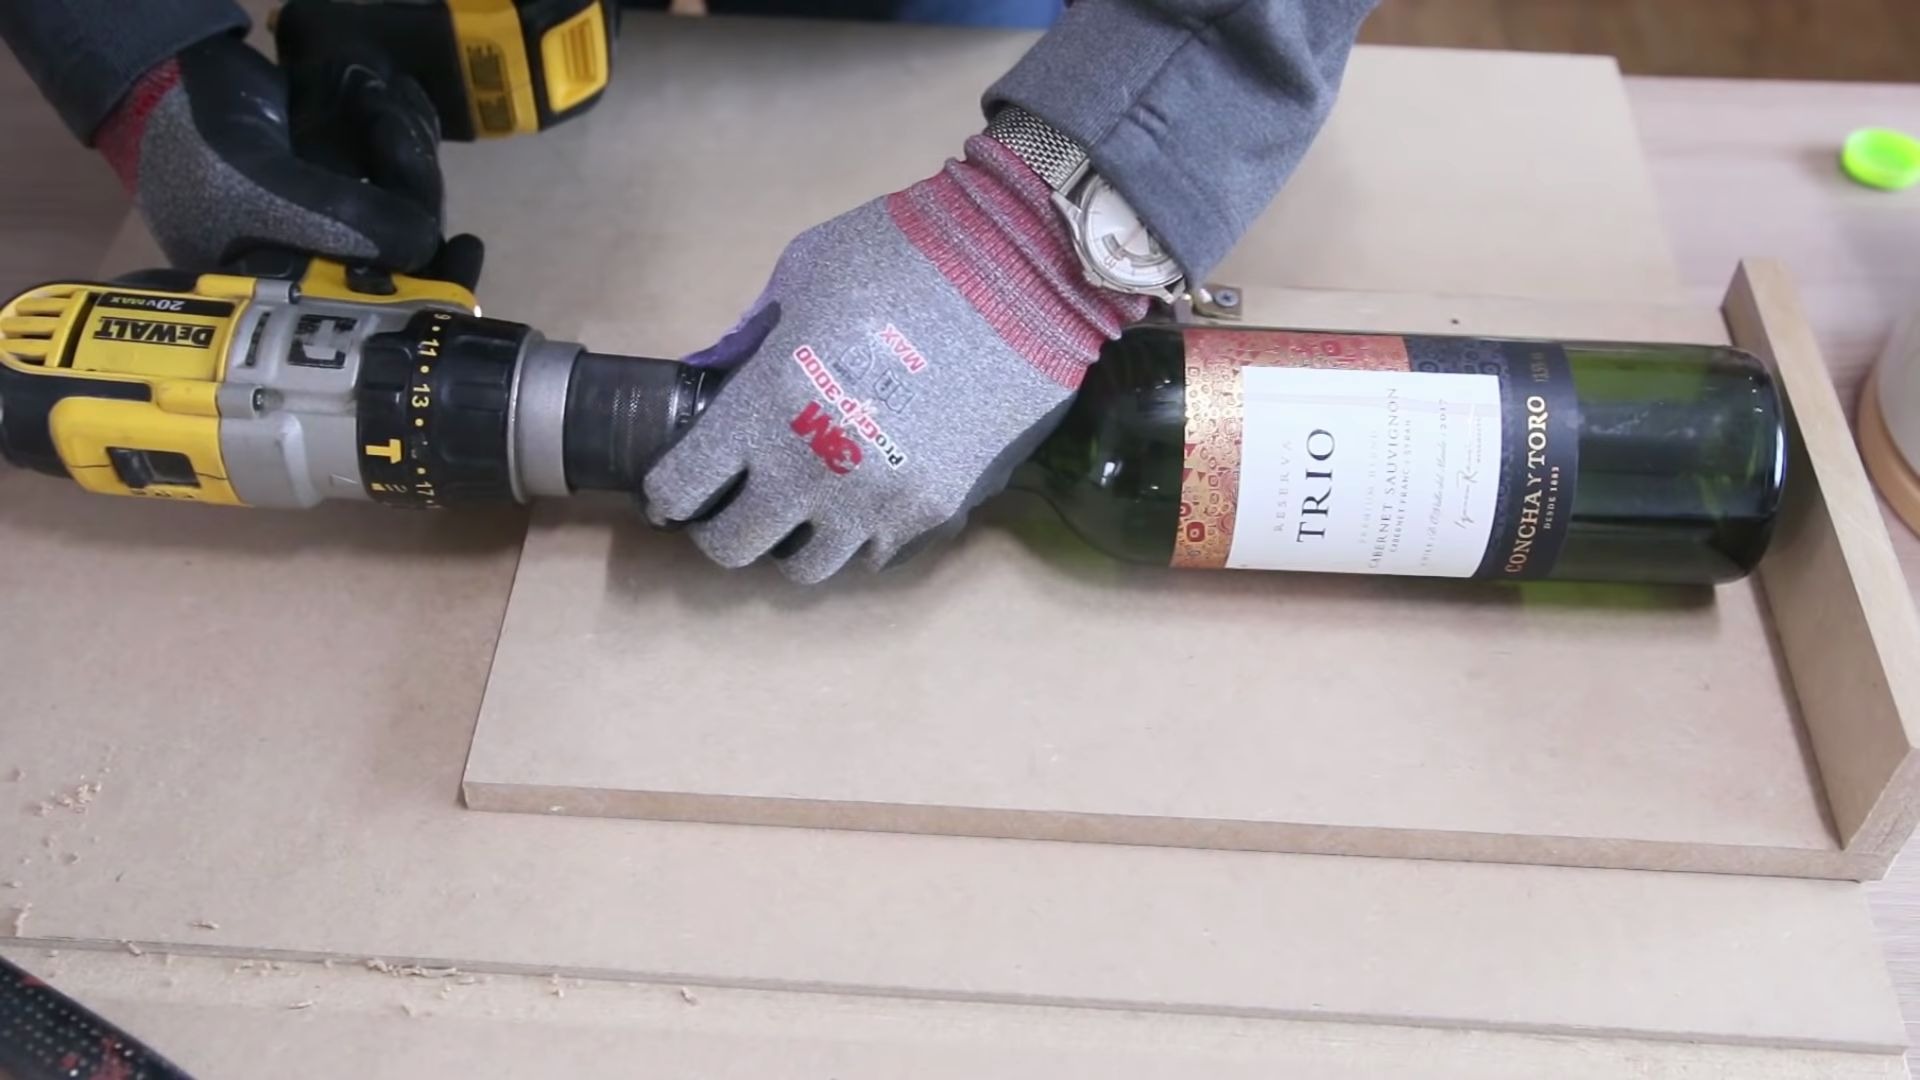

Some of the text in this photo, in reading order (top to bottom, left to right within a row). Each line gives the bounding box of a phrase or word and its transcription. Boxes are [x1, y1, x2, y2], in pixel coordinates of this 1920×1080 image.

[93, 316, 217, 349] DEWALT
[417, 338, 441, 358] 11
[881, 325, 926, 373] MAX
[411, 383, 431, 408] 13
[795, 346, 842, 402] 3000
[789, 400, 863, 476] 3M
[1526, 395, 1548, 470] TORO
[1273, 440, 1292, 533] RESERVA
[1296, 428, 1335, 543] TRIO
[1368, 388, 1400, 569] CABERNET SAUVIGNON
[1527, 473, 1542, 487] Y
[1504, 490, 1542, 573] CONCHA
[1543, 497, 1557, 529] DESDE
